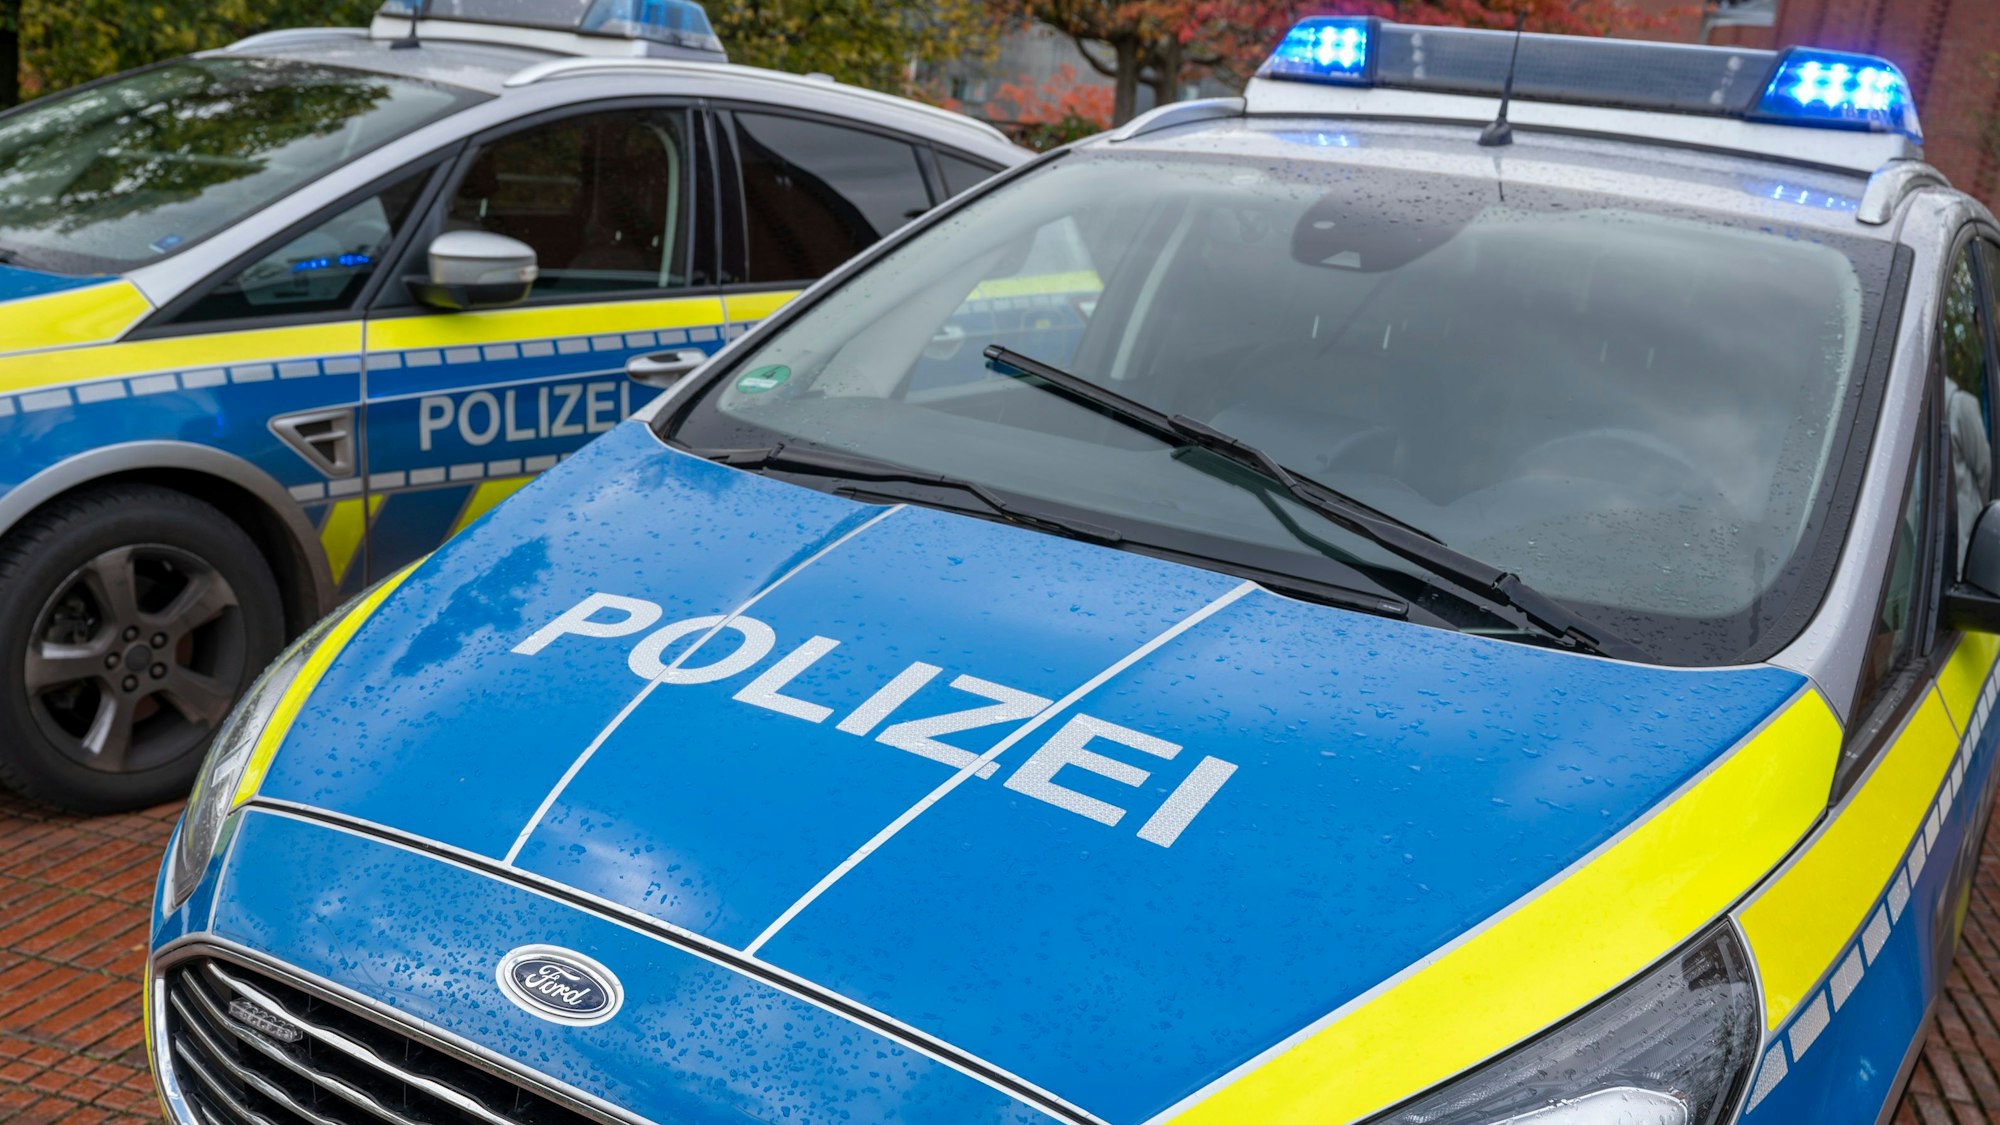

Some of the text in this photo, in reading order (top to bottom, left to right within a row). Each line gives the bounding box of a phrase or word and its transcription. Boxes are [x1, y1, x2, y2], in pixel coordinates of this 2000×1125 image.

[419, 381, 631, 451] POLIZEI
[510, 592, 1239, 848] POLIZEI
[524, 964, 592, 1006] Ford
